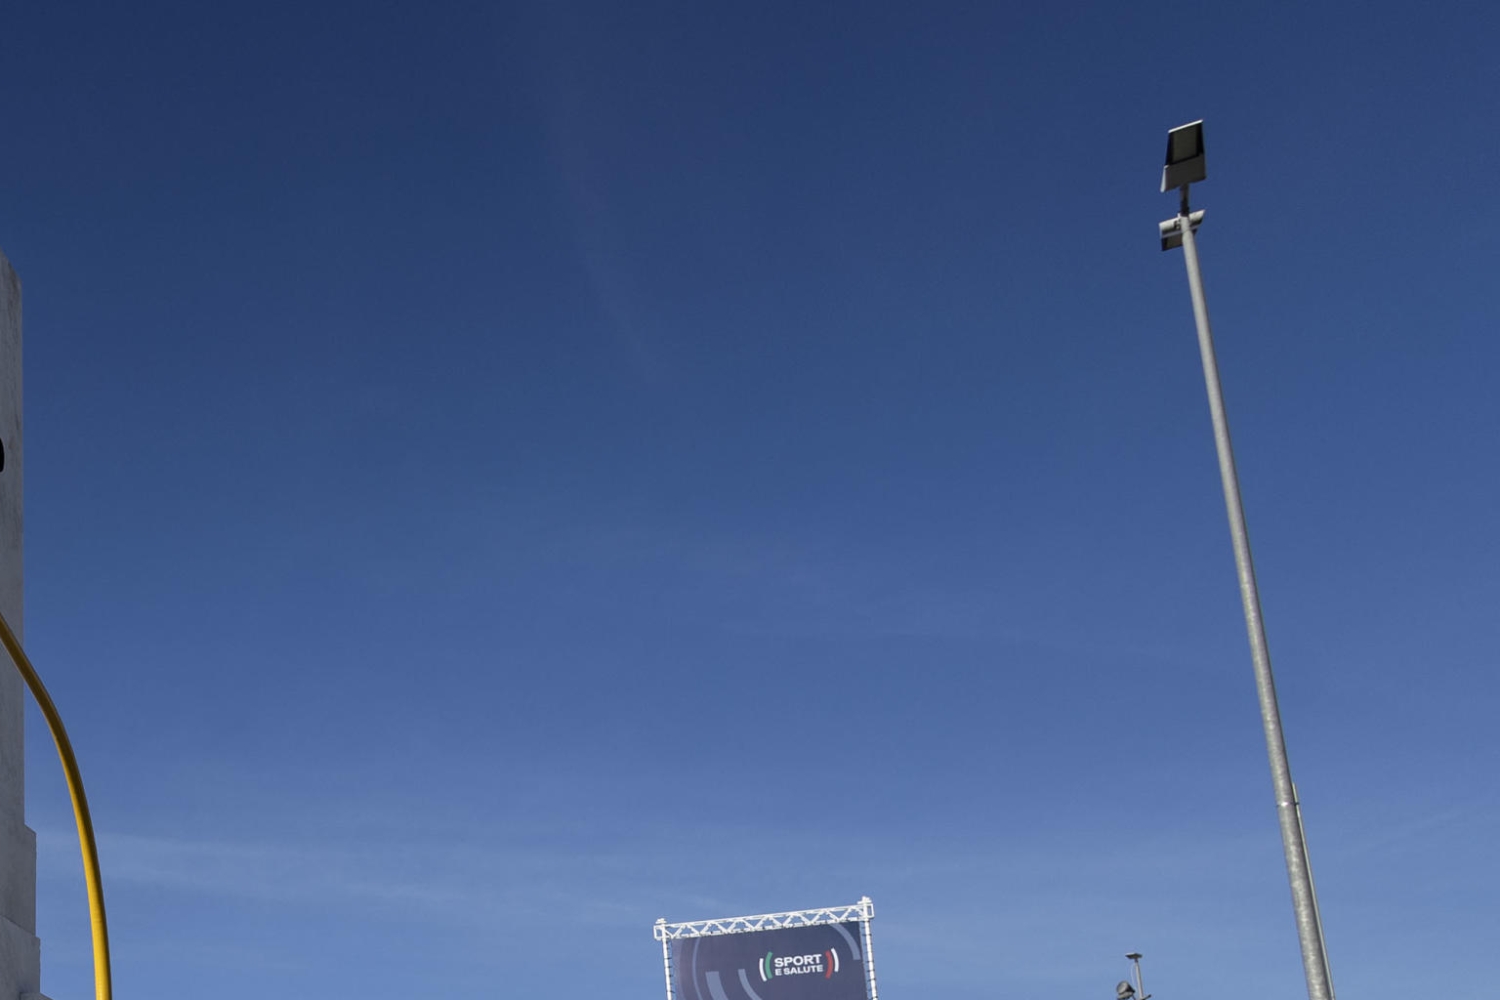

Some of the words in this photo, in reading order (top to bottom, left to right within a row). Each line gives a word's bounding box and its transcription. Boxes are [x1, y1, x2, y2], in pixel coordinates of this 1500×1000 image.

[773, 953, 822, 968] SPORT
[774, 968, 782, 976] E
[783, 964, 824, 975] SALUTE
